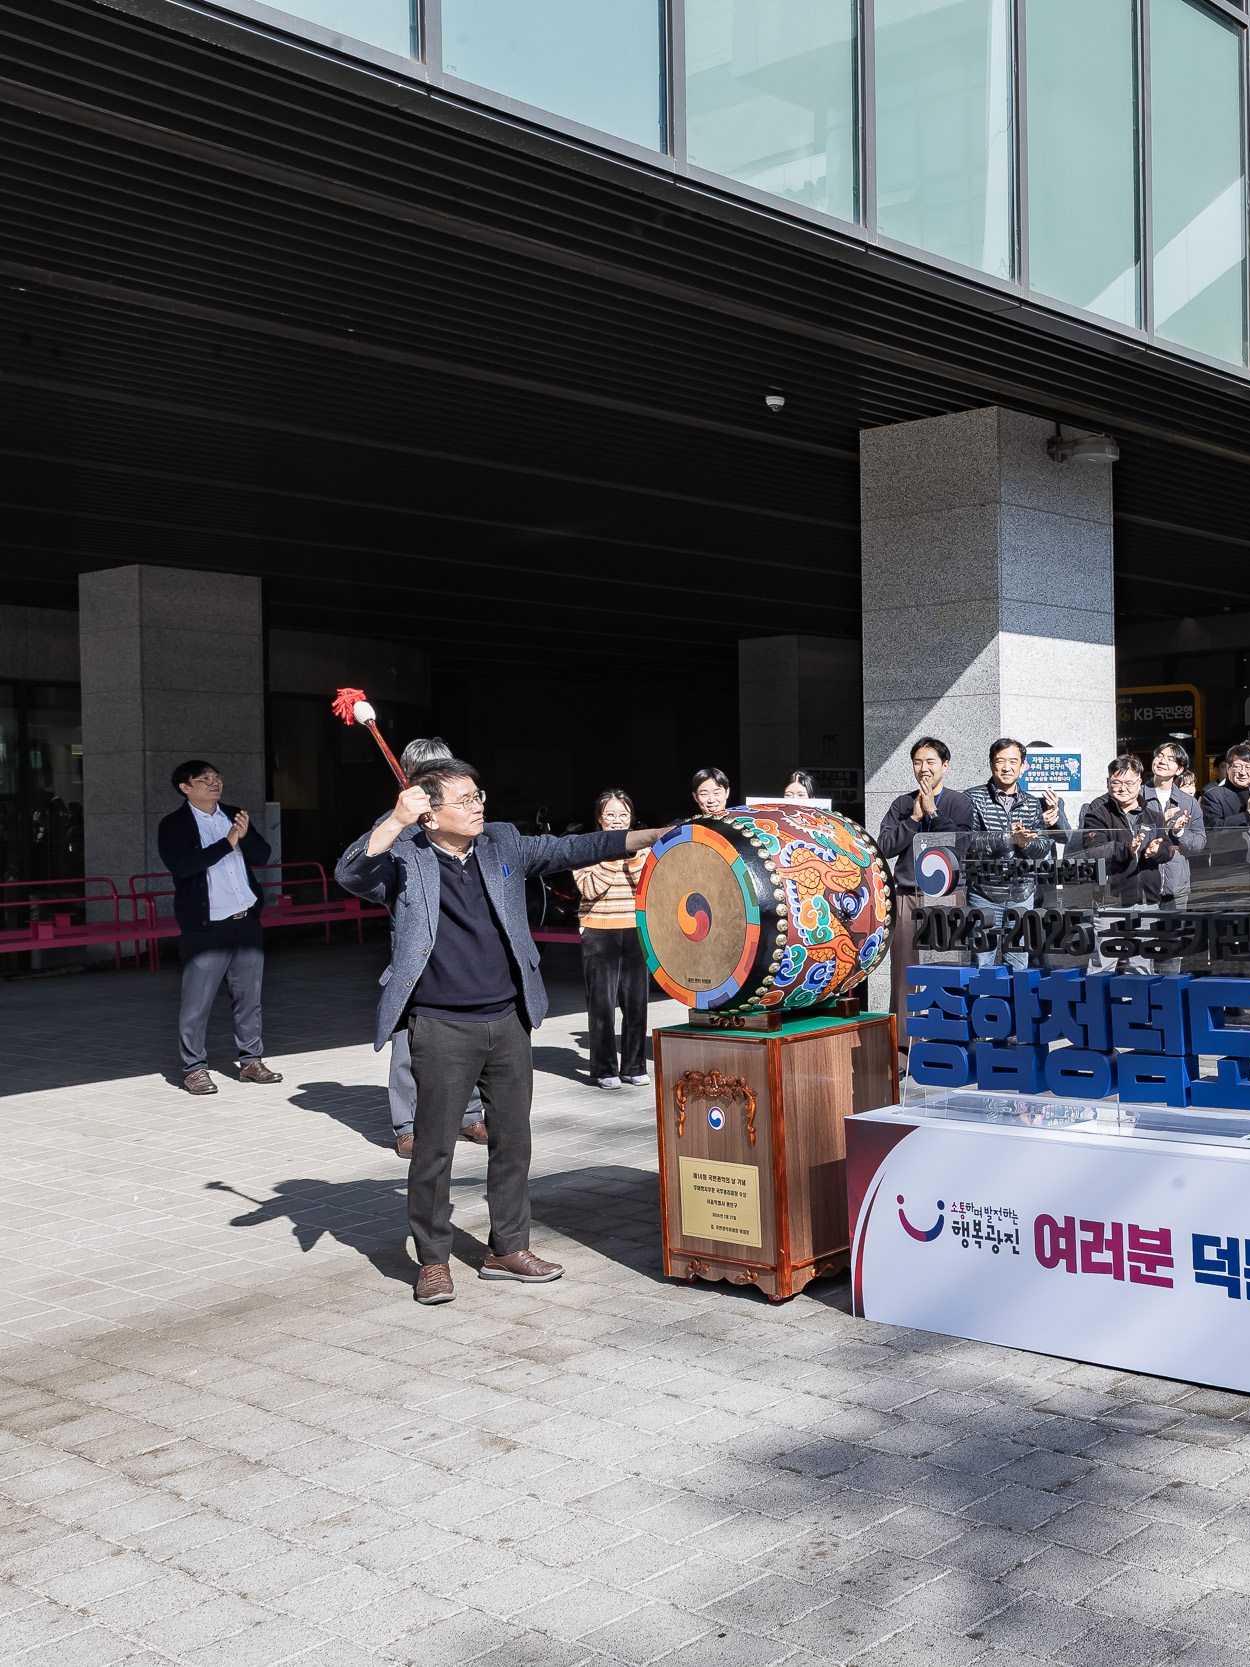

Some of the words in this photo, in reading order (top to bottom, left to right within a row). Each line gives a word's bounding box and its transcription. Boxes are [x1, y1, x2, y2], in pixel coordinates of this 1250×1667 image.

[1133, 705, 1193, 721] KB국민은행
[911, 905, 1095, 957] 2023-2025
[951, 1202, 983, 1219] 소통하며
[984, 1205, 1019, 1225] 발전하는
[952, 1219, 1020, 1255] 행복광진
[1034, 1213, 1174, 1289] 여러분
